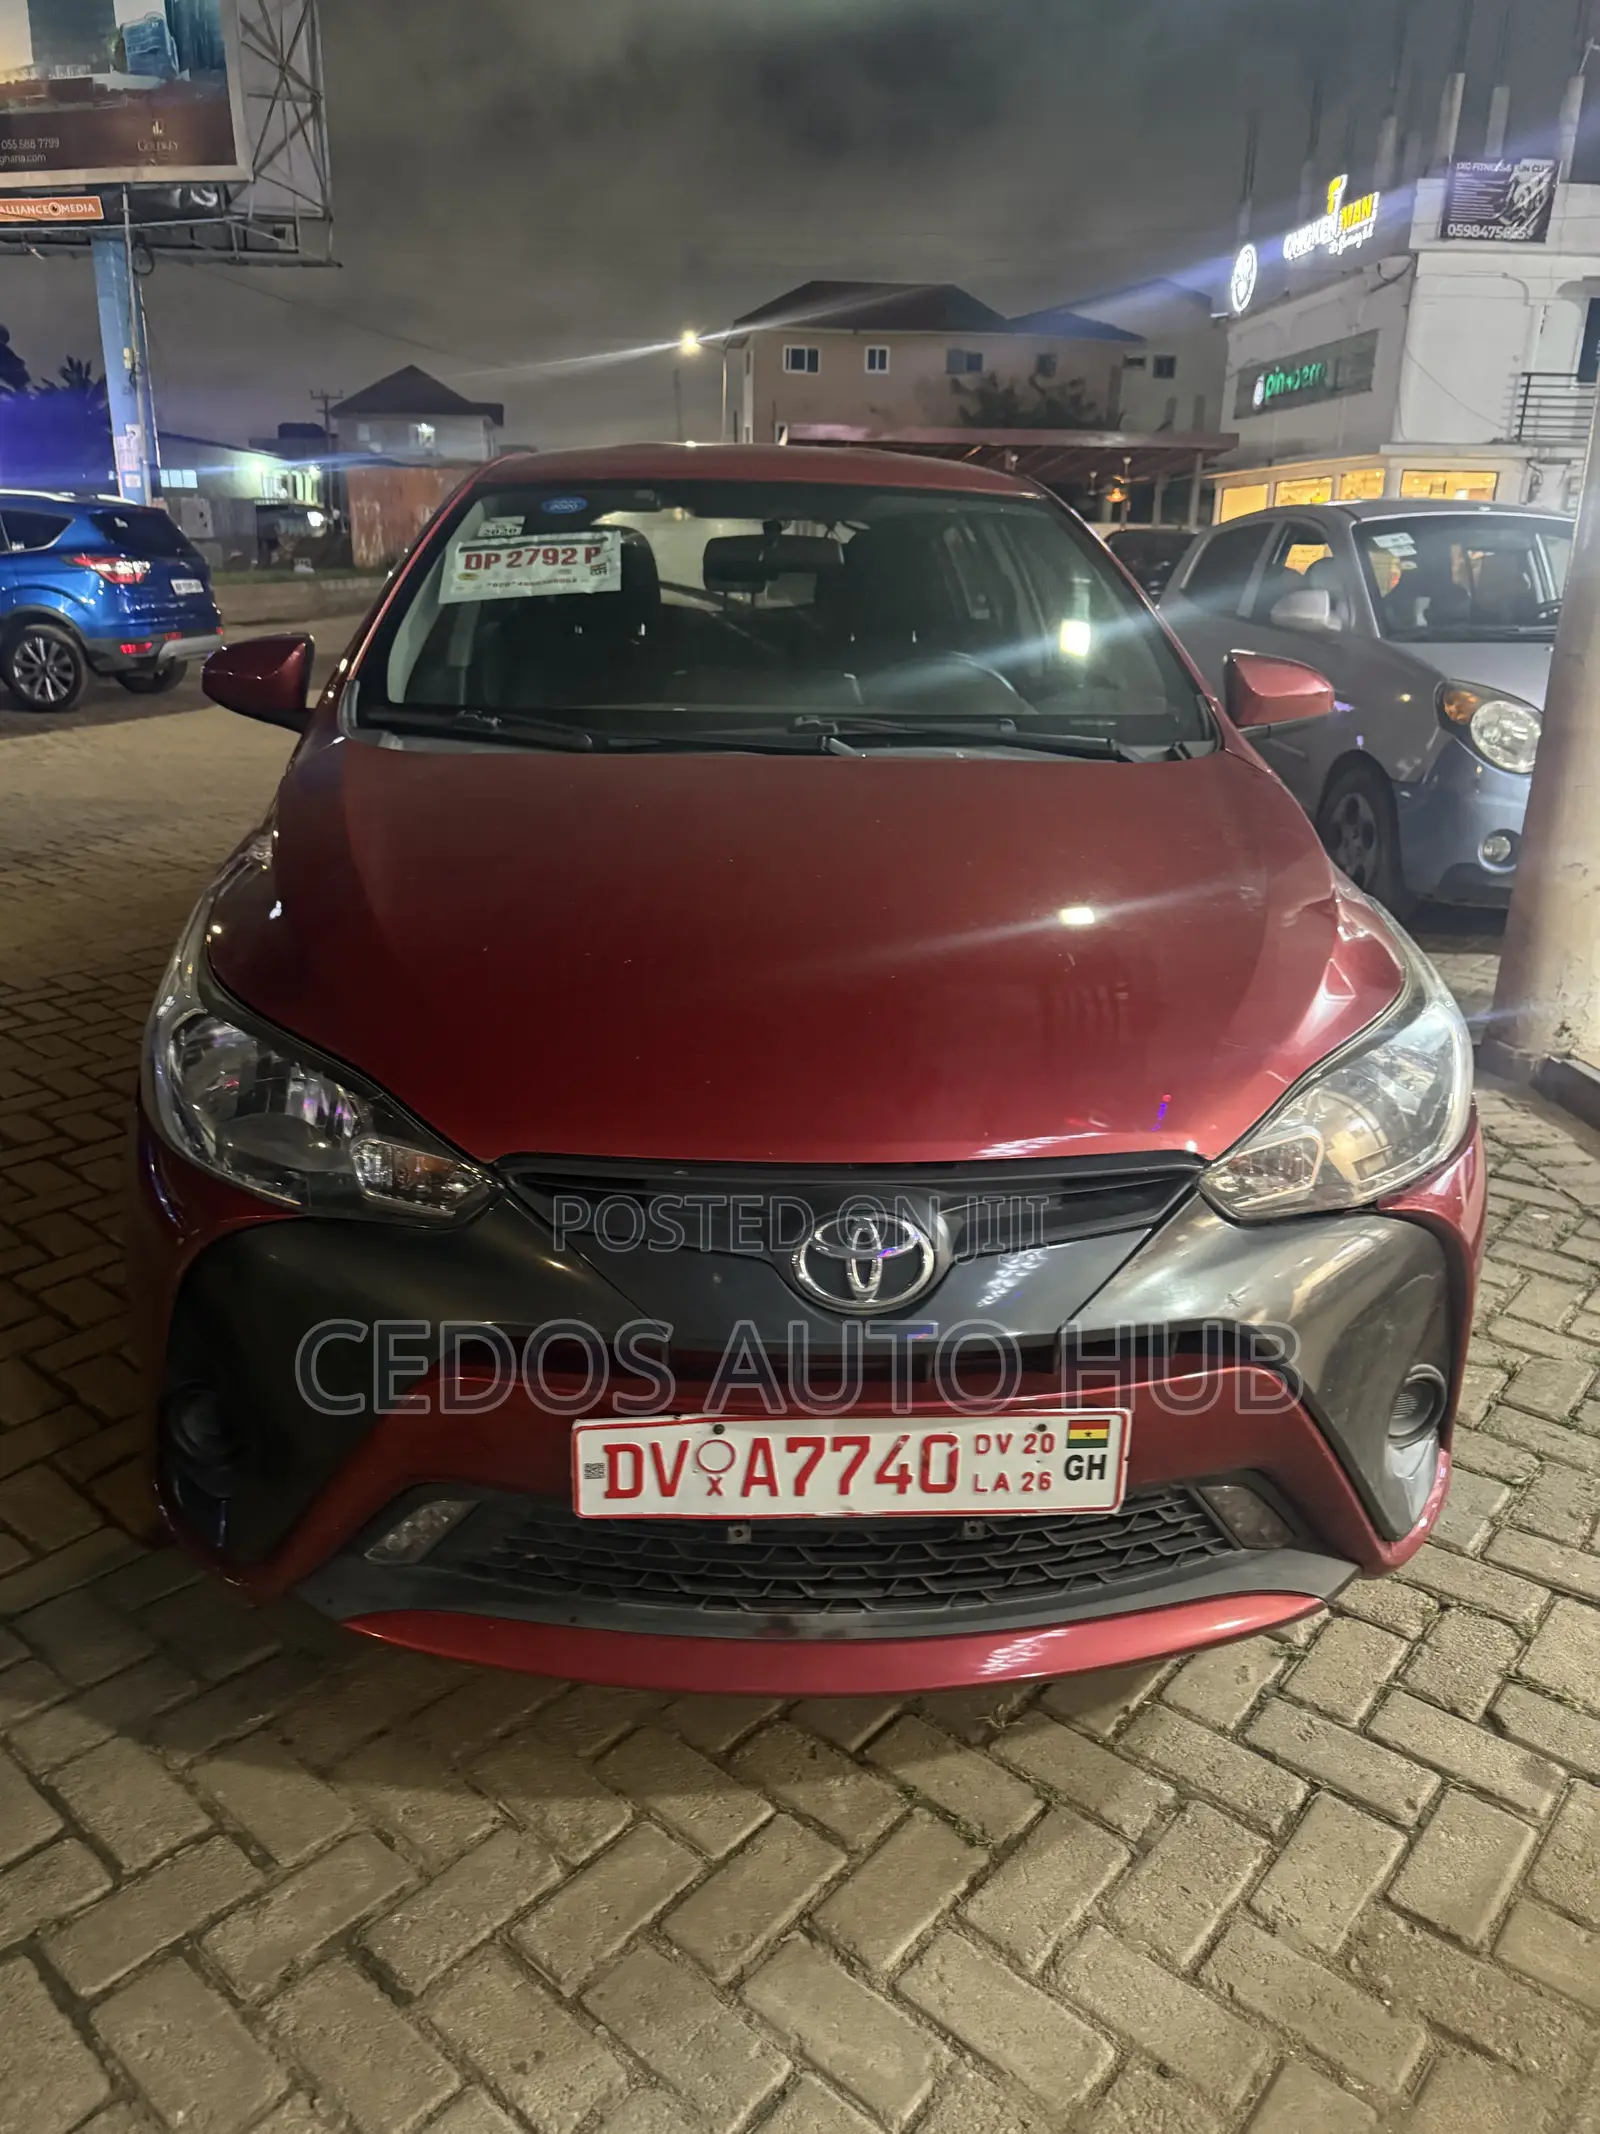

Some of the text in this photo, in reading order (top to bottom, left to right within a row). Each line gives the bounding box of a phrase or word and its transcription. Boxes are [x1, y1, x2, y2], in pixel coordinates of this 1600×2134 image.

[60, 203, 96, 213] MEDIA
[1340, 192, 1374, 233] MAN
[506, 547, 577, 568] 2792
[974, 1431, 1055, 1454] DV 20
[603, 1433, 960, 1499] DV A7740
[1063, 1454, 1108, 1481] GH
[973, 1471, 1053, 1493] LA 26
